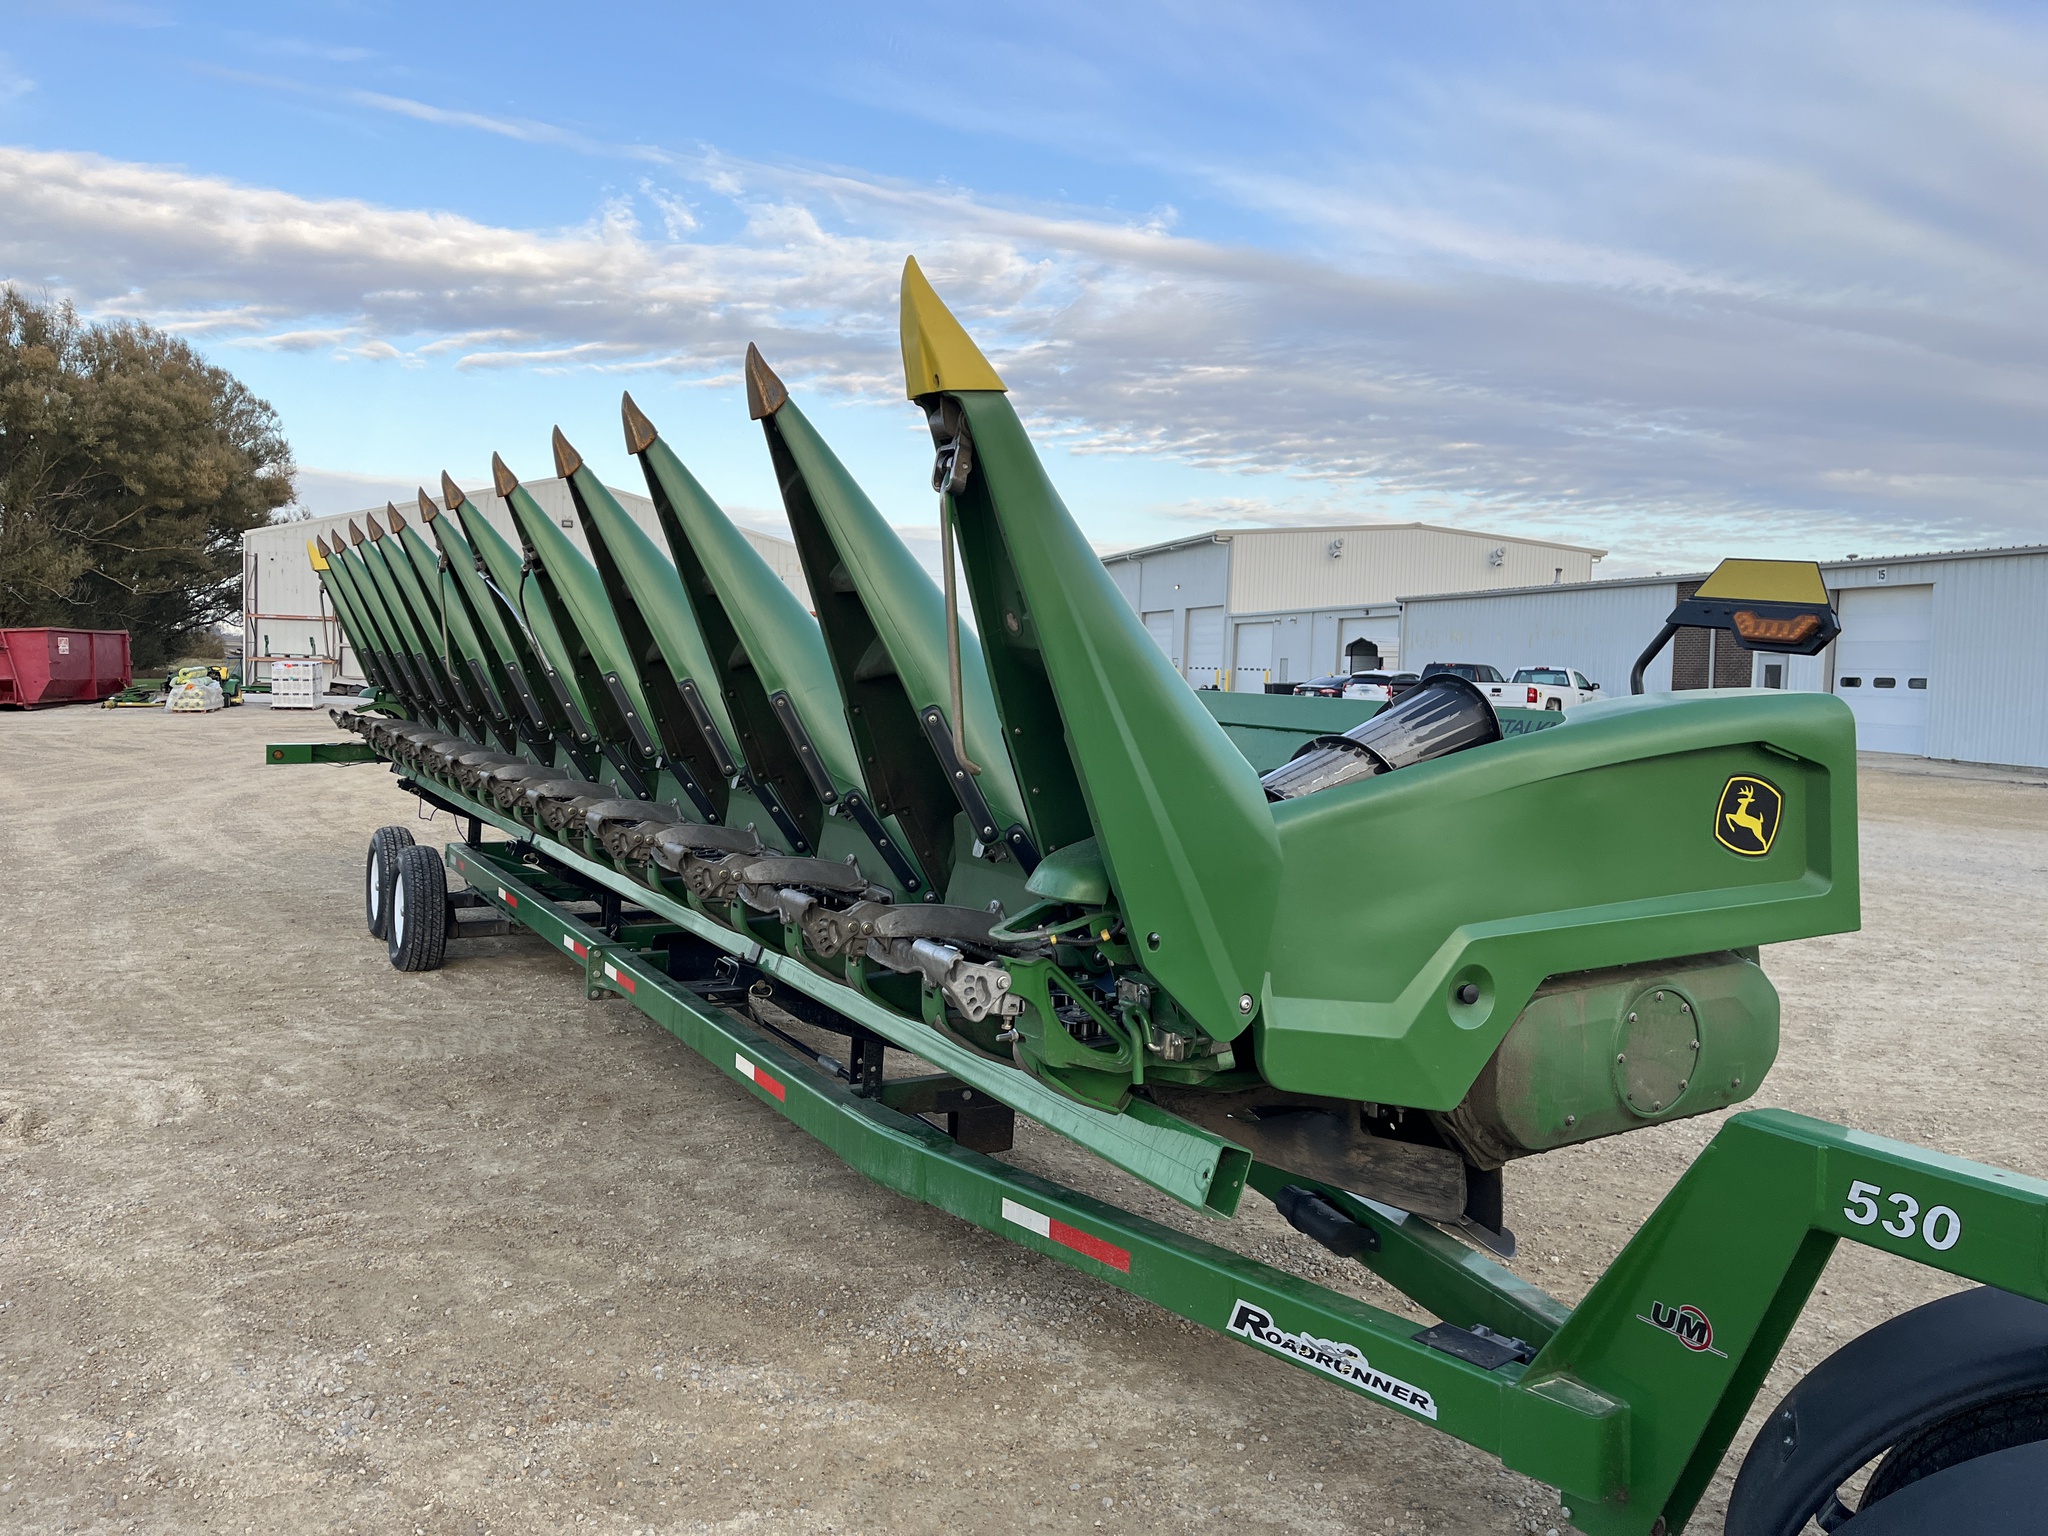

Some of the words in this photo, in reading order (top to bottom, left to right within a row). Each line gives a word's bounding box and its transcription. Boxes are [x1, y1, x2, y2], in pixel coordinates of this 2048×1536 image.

[1878, 569, 1886, 580] 15
[1842, 1179, 1961, 1251] 530
[1651, 1300, 1708, 1345] UM
[1232, 1304, 1430, 1411] ROADRUNNER
